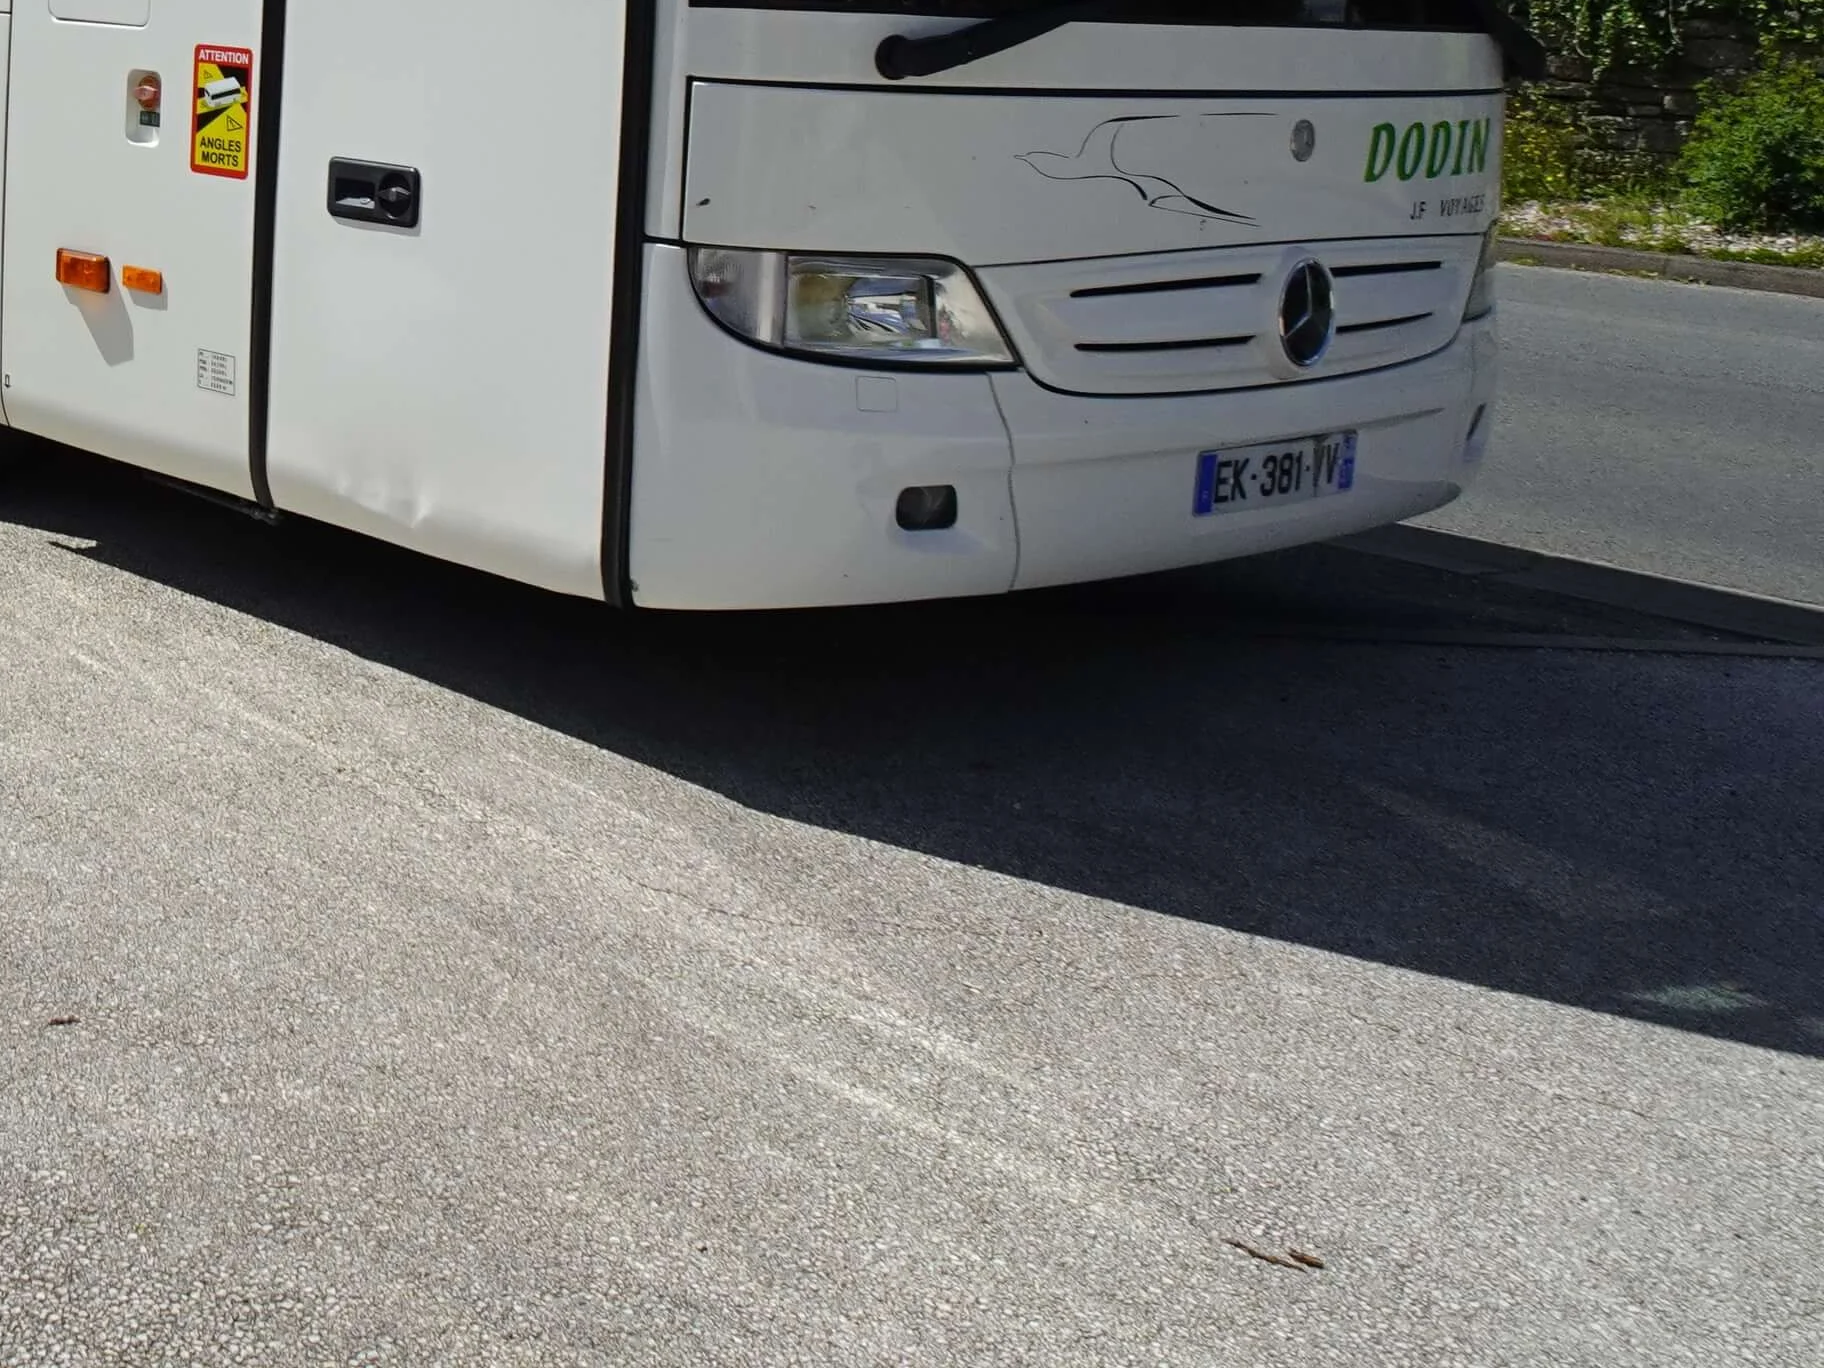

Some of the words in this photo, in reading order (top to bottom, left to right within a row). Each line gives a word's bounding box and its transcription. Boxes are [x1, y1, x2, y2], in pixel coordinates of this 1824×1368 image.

[198, 49, 249, 64] ATTENTION
[200, 136, 241, 152] ANGLES
[1363, 117, 1490, 183] DODIN
[201, 151, 239, 167] MORTS
